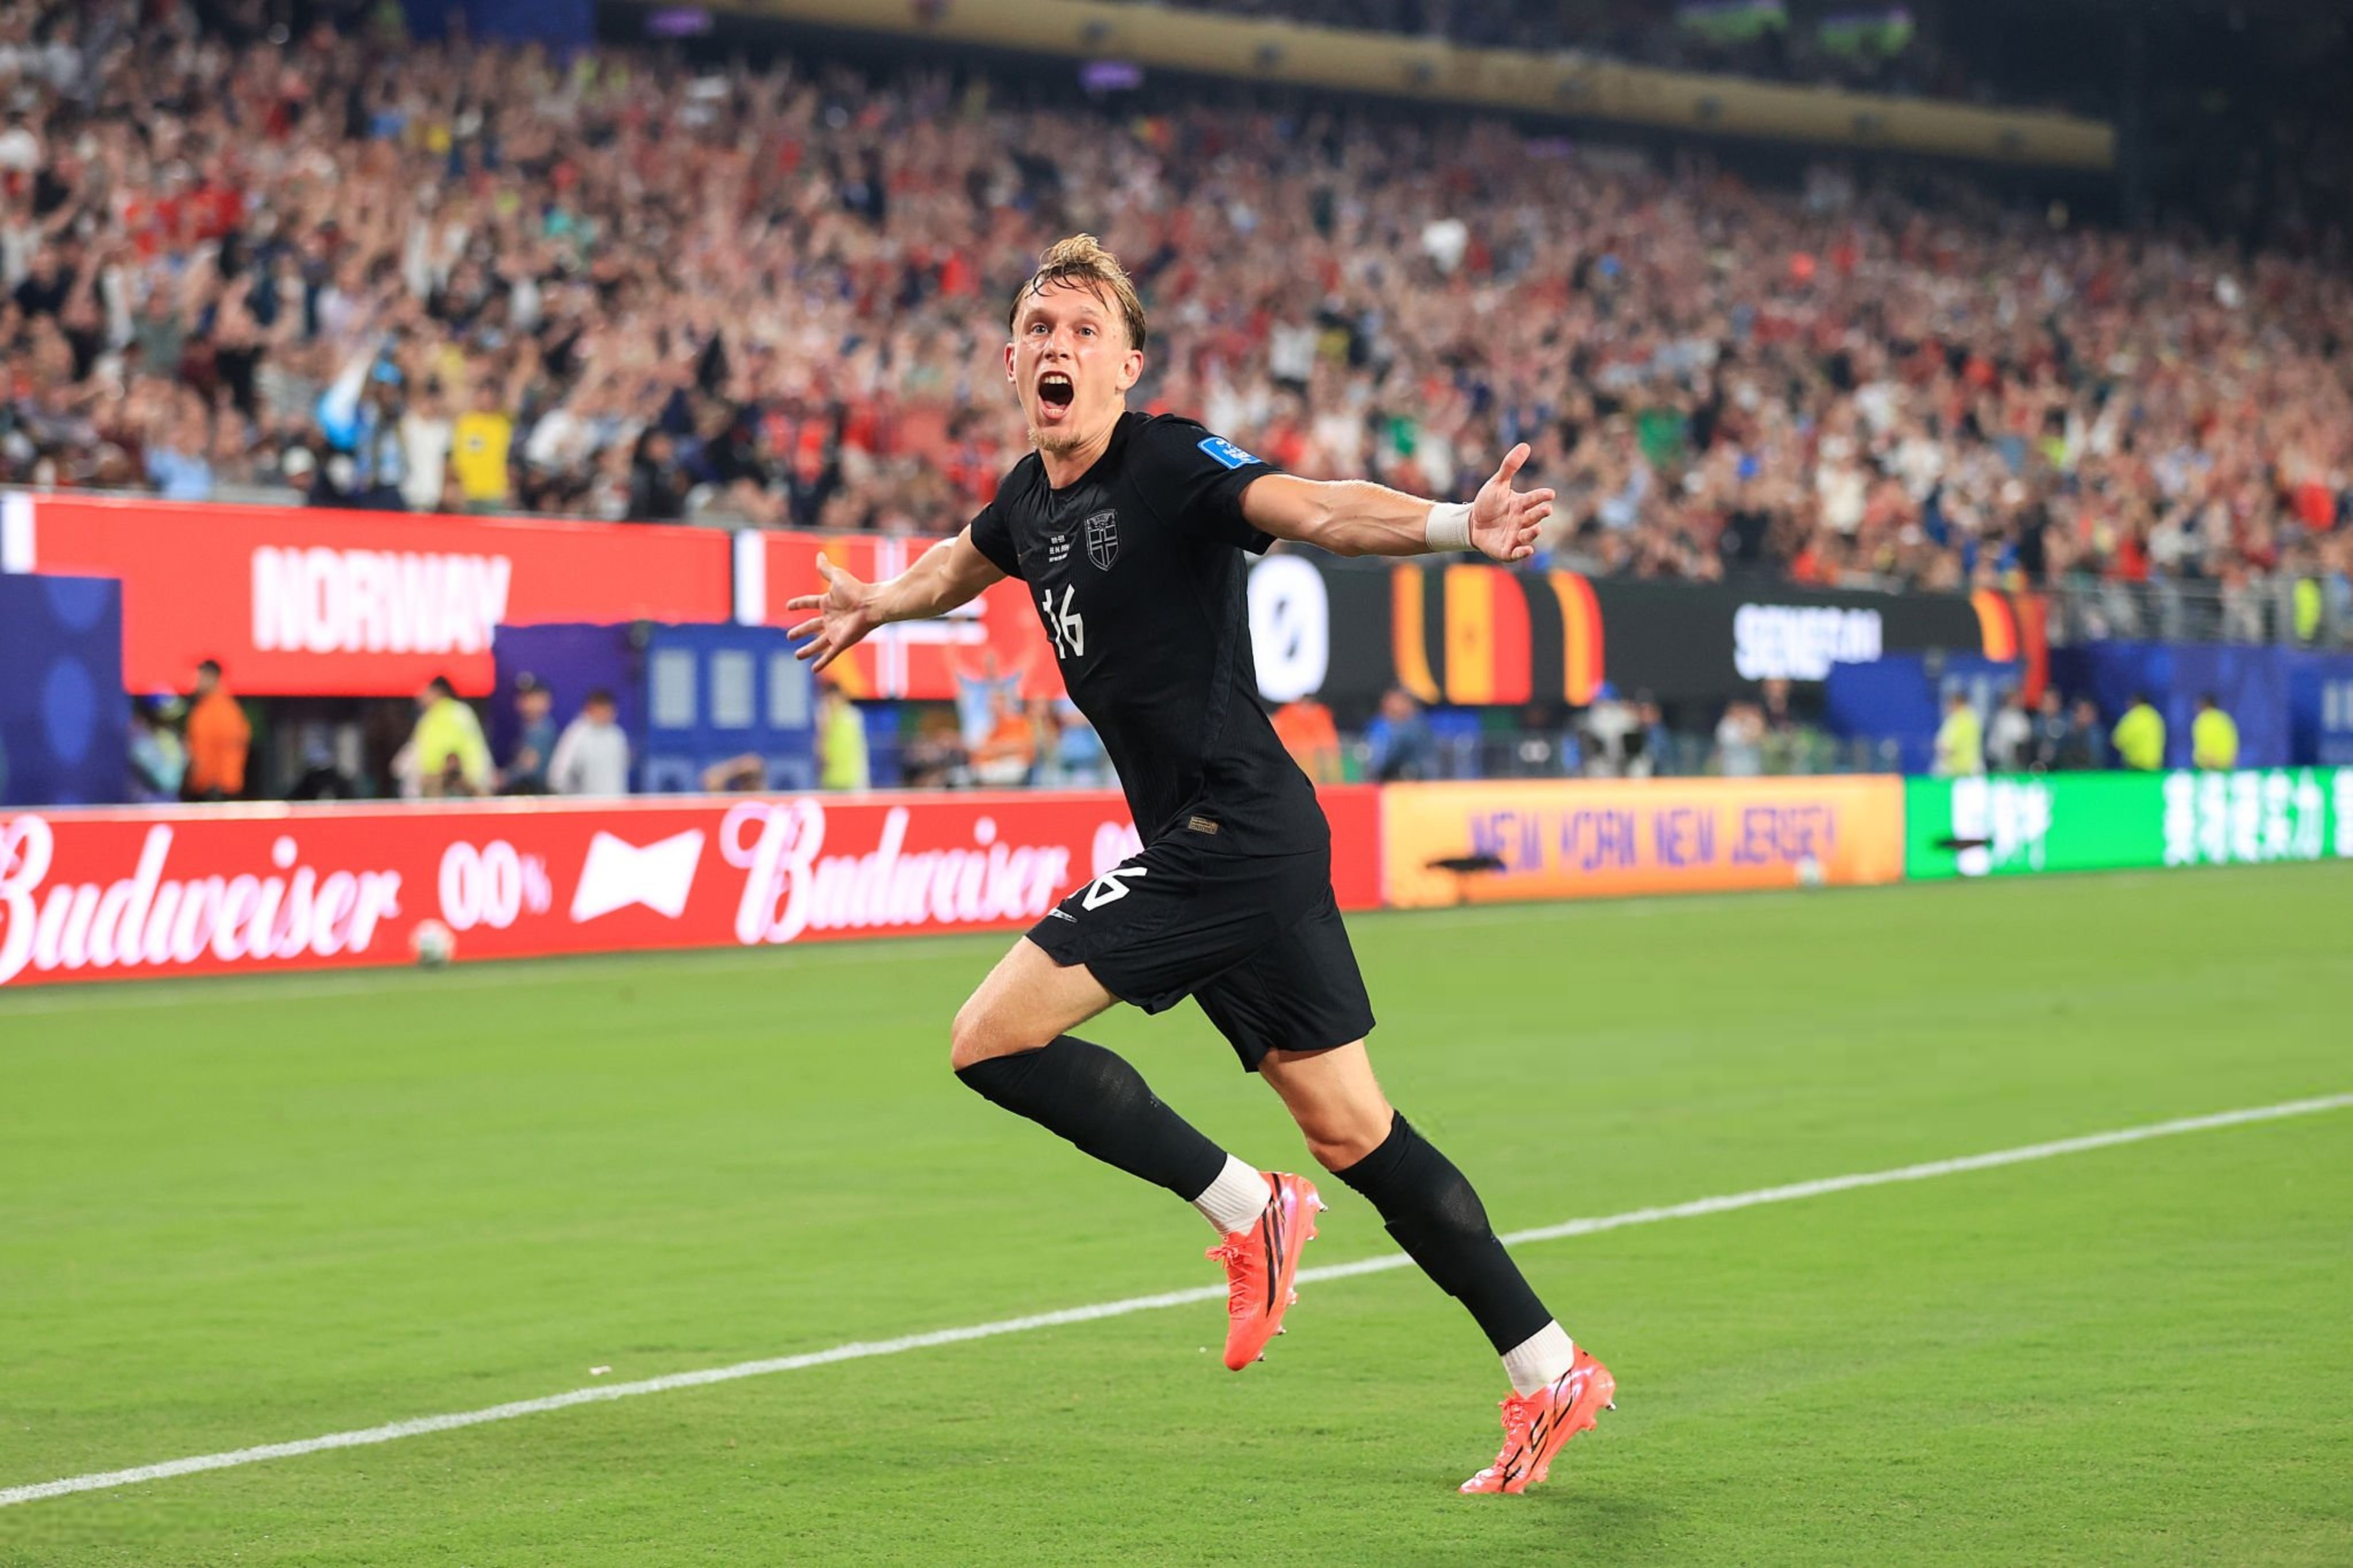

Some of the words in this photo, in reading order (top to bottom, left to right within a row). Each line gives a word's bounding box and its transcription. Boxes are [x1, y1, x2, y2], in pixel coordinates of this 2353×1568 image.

[252, 546, 511, 654] NORWAY
[1042, 584, 1084, 659] 16
[1248, 555, 1329, 703] 0
[720, 798, 1069, 944] Budweiser
[1067, 867, 1148, 912] 6
